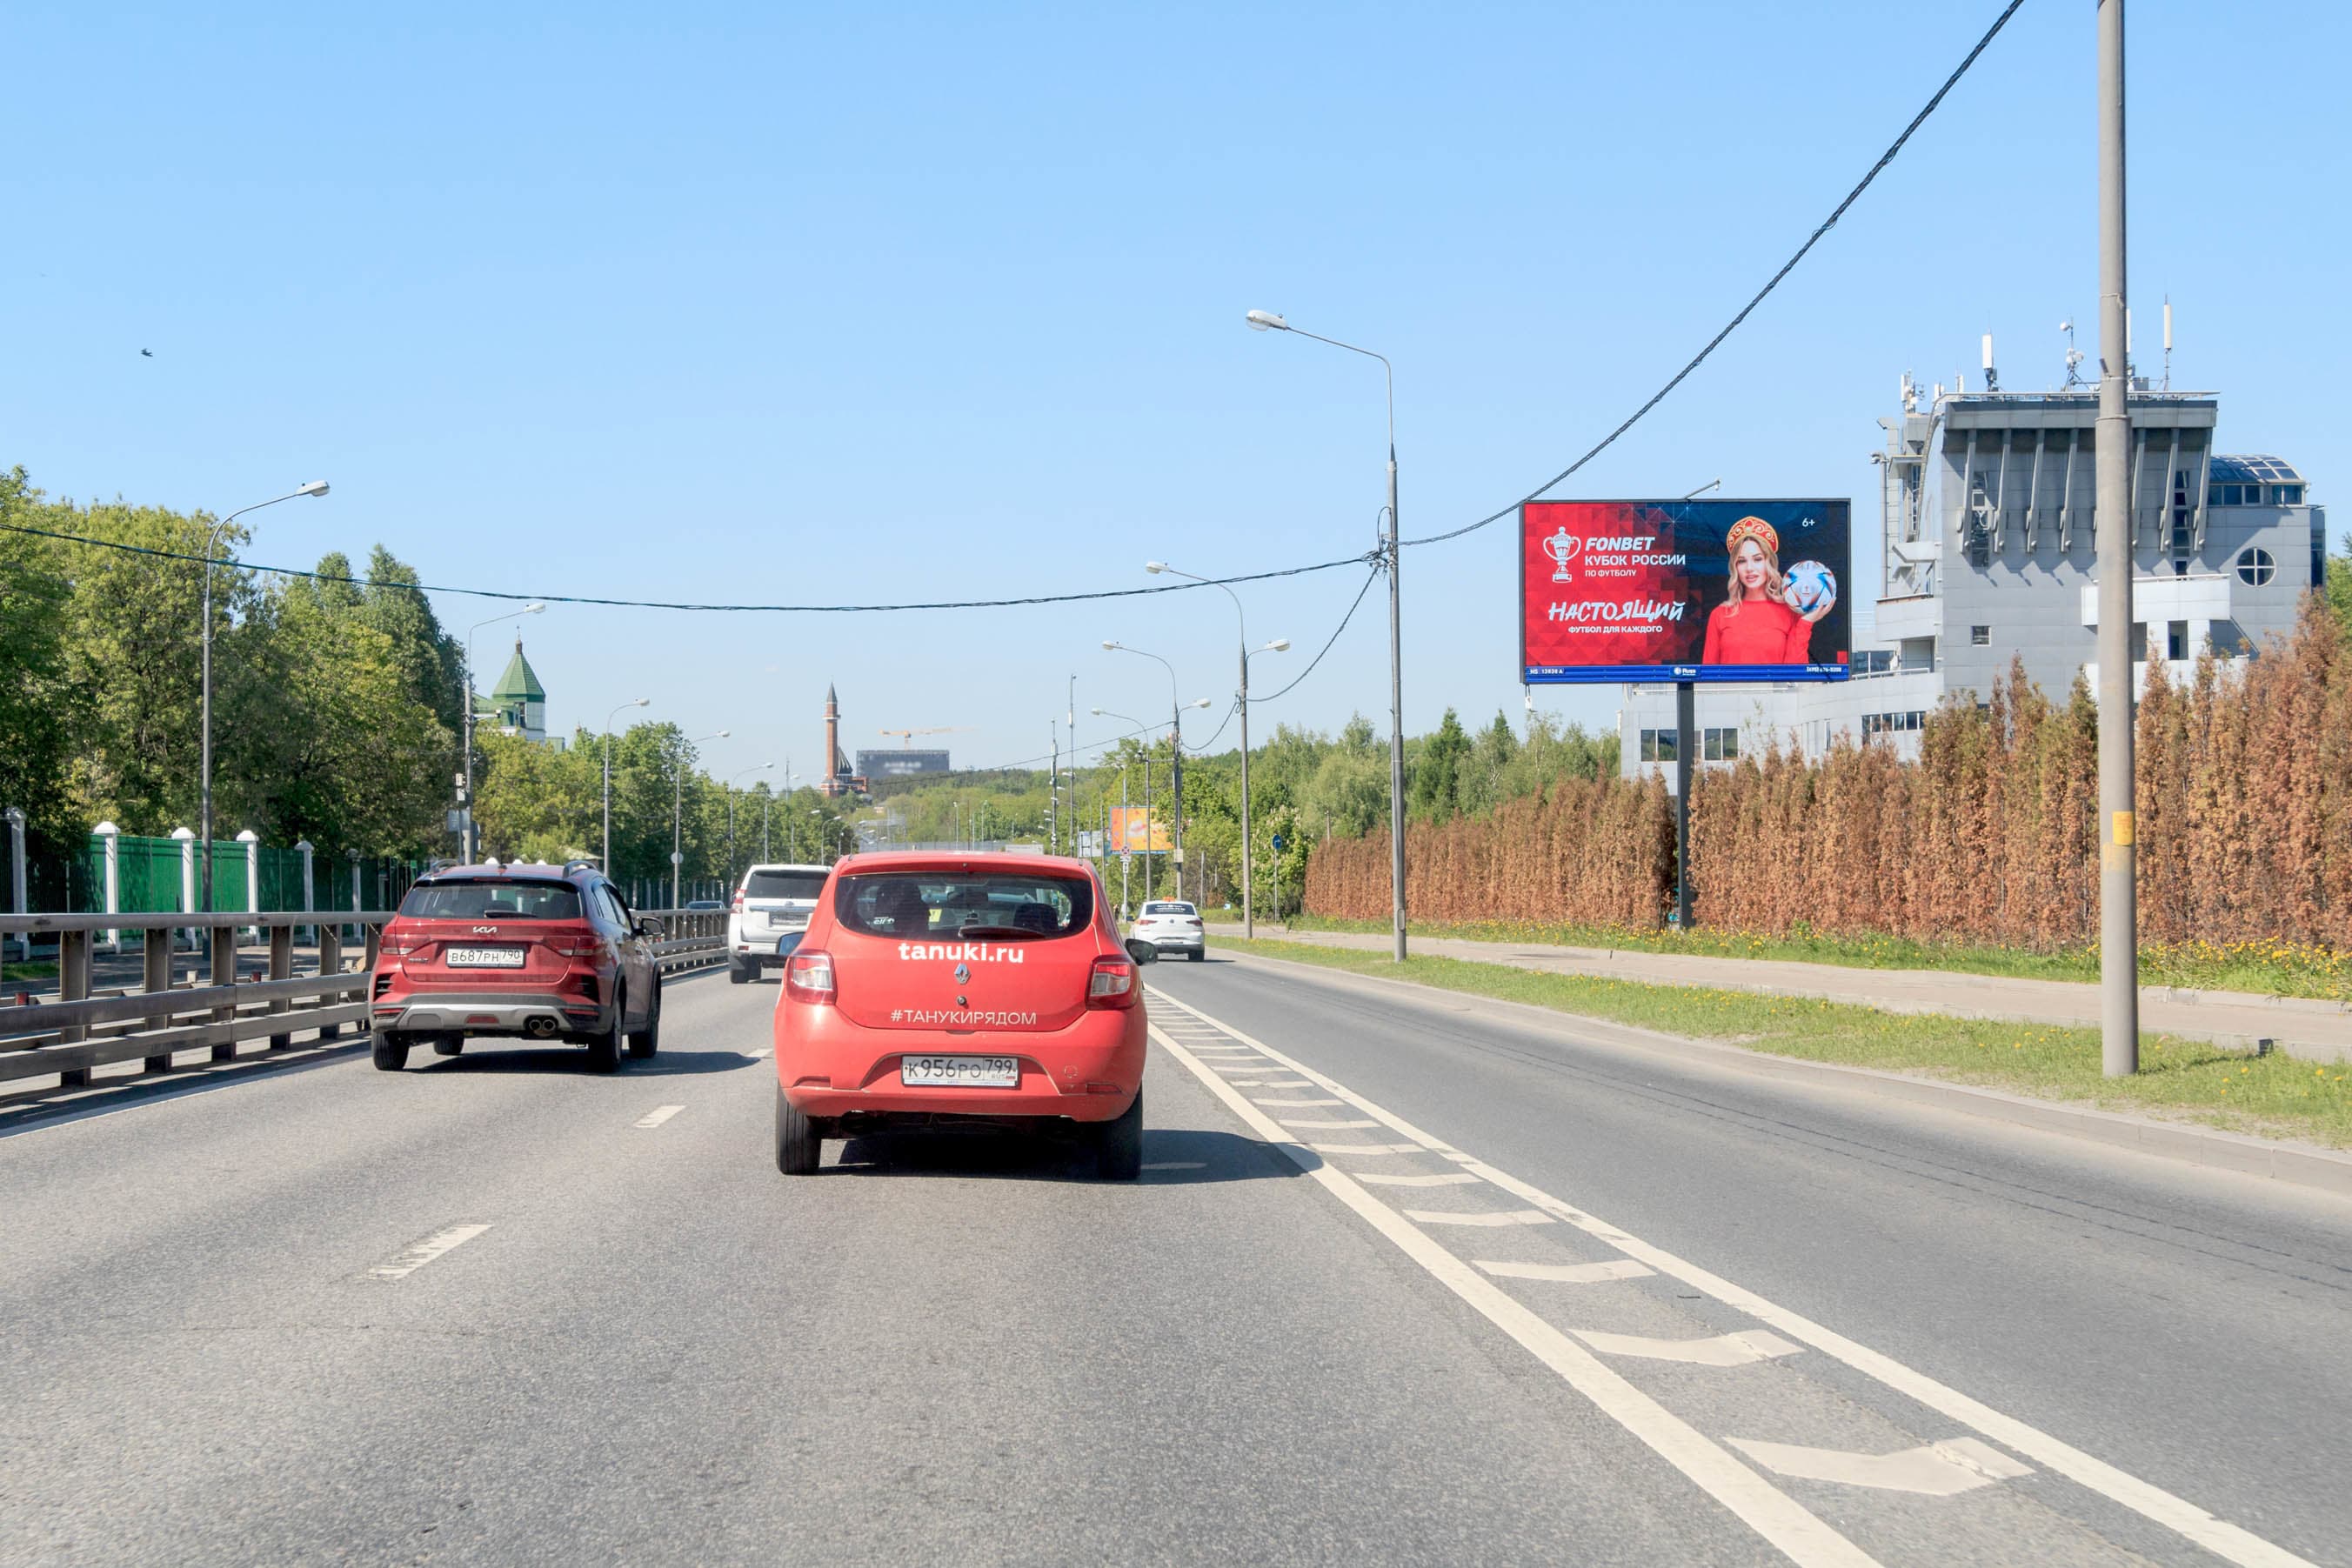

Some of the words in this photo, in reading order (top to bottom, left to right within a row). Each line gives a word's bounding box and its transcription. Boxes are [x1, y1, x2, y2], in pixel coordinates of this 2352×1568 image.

[1802, 517, 1815, 527] 6+
[1585, 537, 1655, 551] FONBET
[1584, 555, 1627, 566] КУБОК
[1632, 554, 1686, 565] РОССИИ
[1548, 599, 1686, 623] НАСТОЯЩИЙ
[1568, 625, 1601, 634] ФУТБОЛ
[1603, 625, 1620, 634] ДЛЯ
[898, 942, 1024, 964] tanuki.ru
[890, 1009, 1037, 1025] #ТАНУКИРЯДОМ
